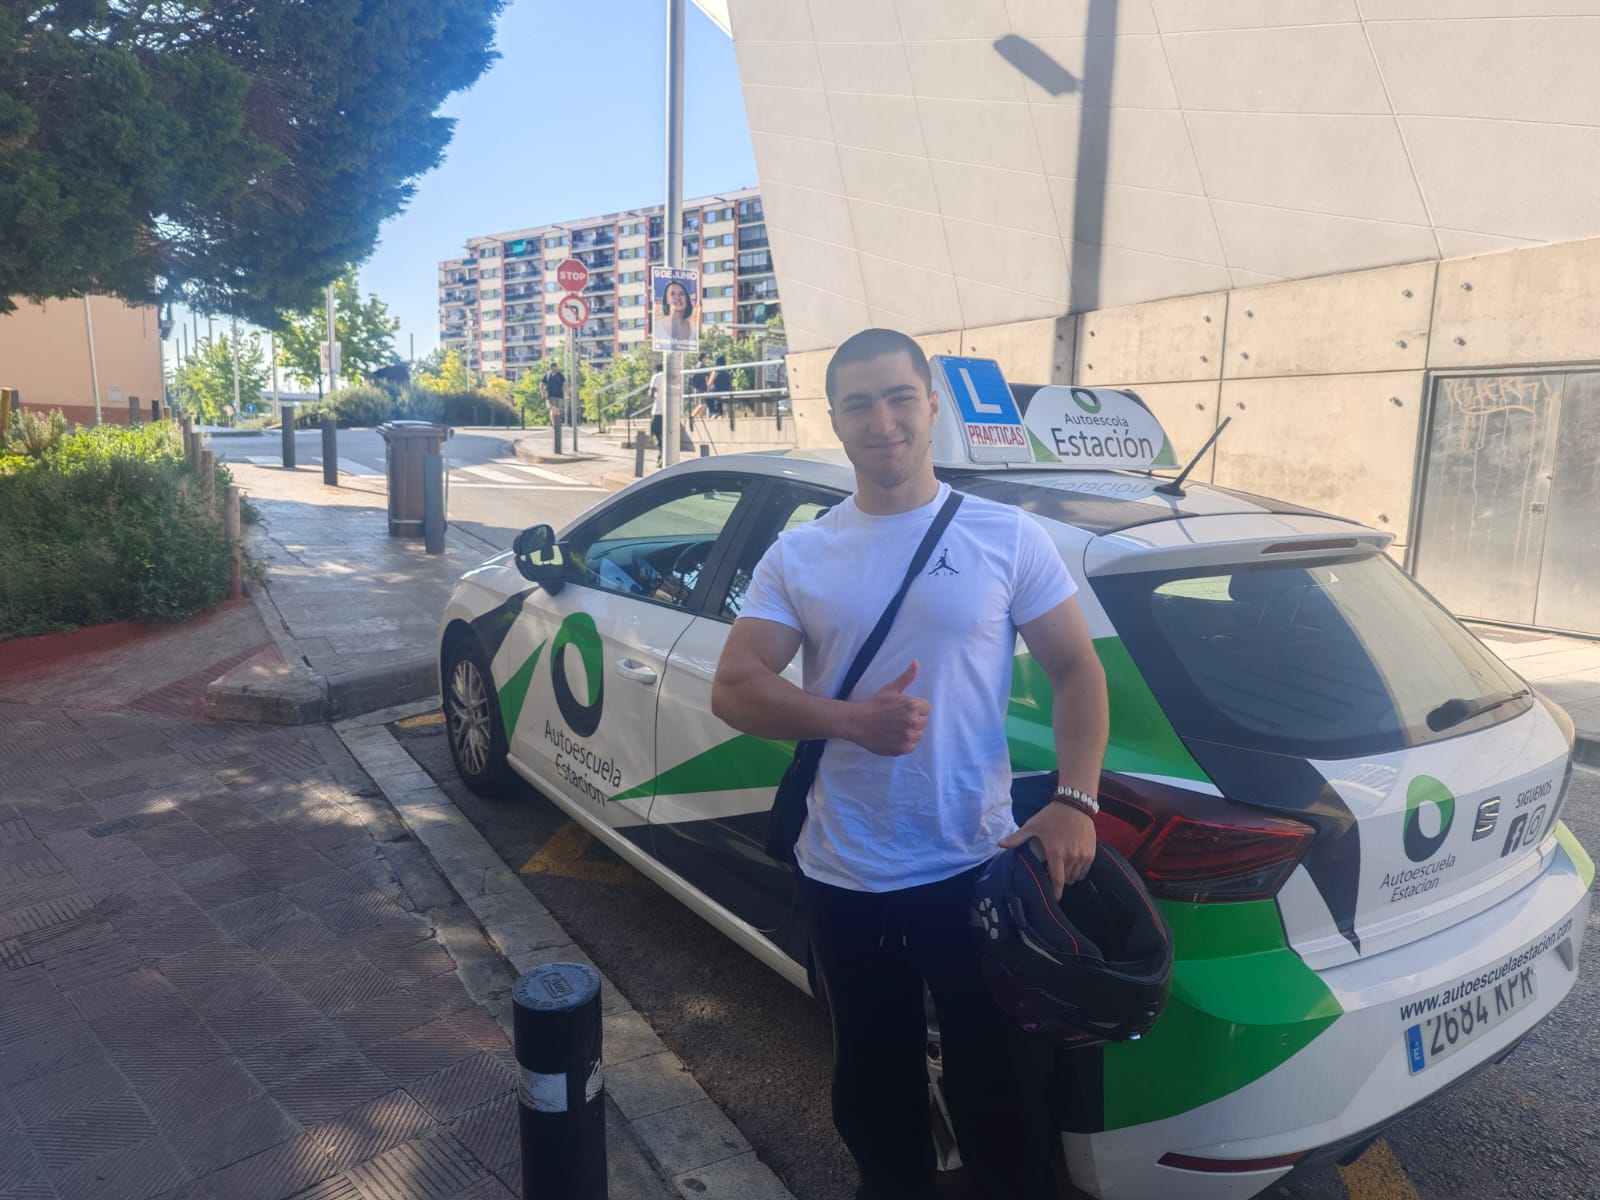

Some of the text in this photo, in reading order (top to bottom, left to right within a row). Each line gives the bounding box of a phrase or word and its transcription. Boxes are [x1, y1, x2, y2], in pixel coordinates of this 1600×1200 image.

[559, 271, 586, 280] STOP
[661, 269, 673, 279] DE
[672, 270, 698, 281] JUNIO
[959, 367, 1003, 415] L
[968, 423, 1026, 447] PRACTICAS
[1064, 412, 1130, 428] Autoescola
[1050, 427, 1155, 459] Estación
[544, 719, 622, 788] Autoescuela
[554, 753, 606, 808] Estacion
[1514, 778, 1553, 809] SIGUENOS
[1380, 852, 1457, 890] Autoescuela
[1390, 876, 1440, 903] Estacion
[1400, 918, 1573, 1021] www.autoescuelaestacion.com
